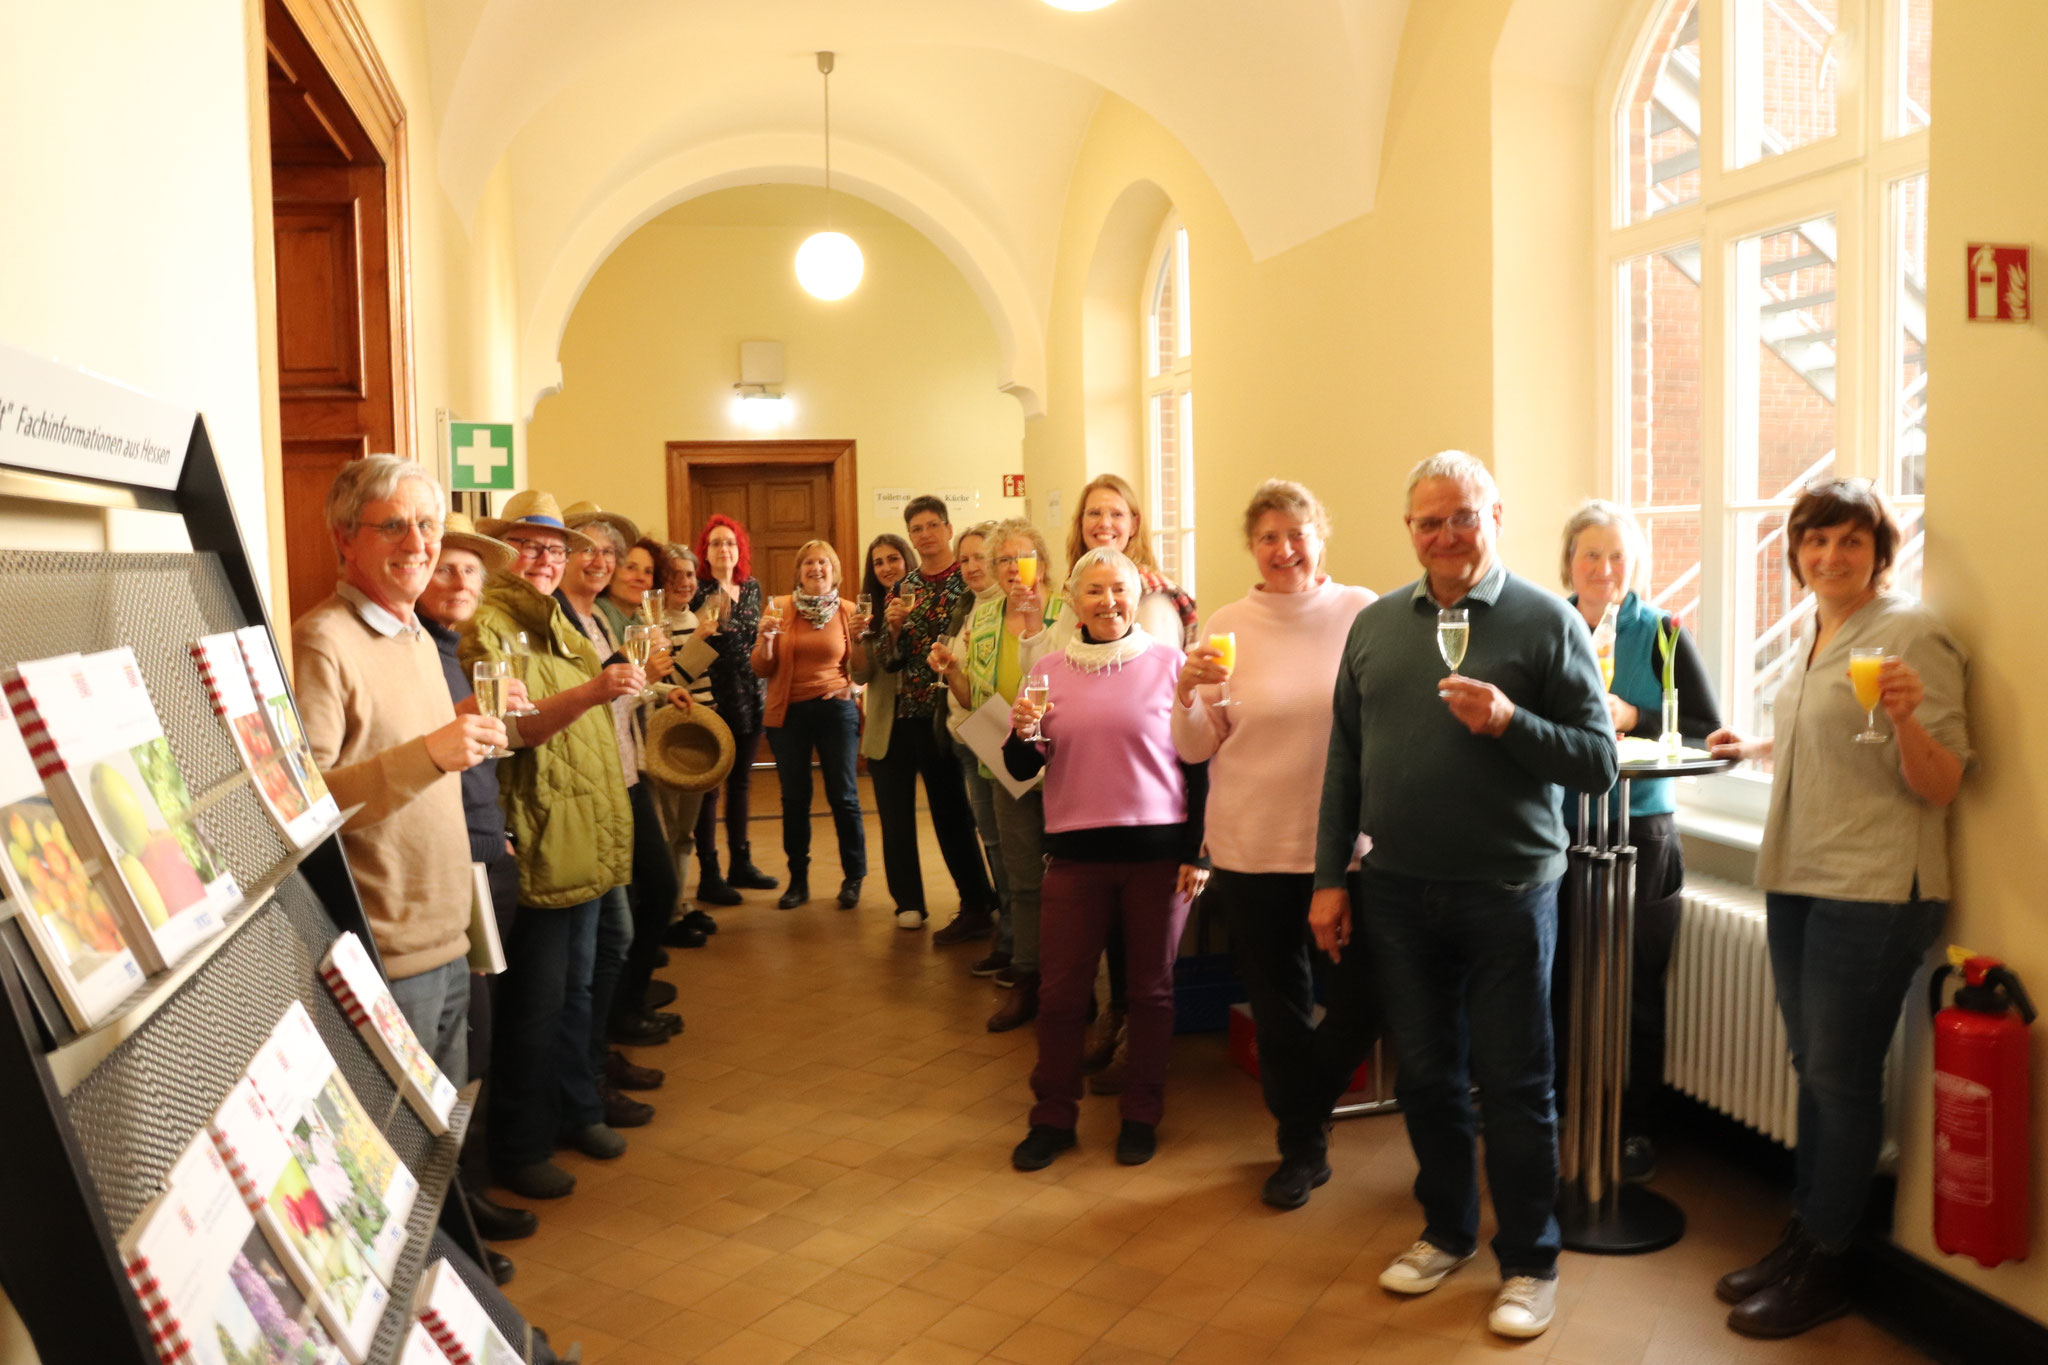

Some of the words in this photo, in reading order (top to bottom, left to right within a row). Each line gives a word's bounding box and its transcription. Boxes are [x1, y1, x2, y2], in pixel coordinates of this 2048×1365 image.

[0, 397, 14, 431] t"
[16, 404, 123, 456] Fachinformationen
[123, 438, 141, 459] aus
[140, 437, 171, 465] Hessen
[876, 492, 911, 502] Toiletten
[944, 493, 970, 502] Küche
